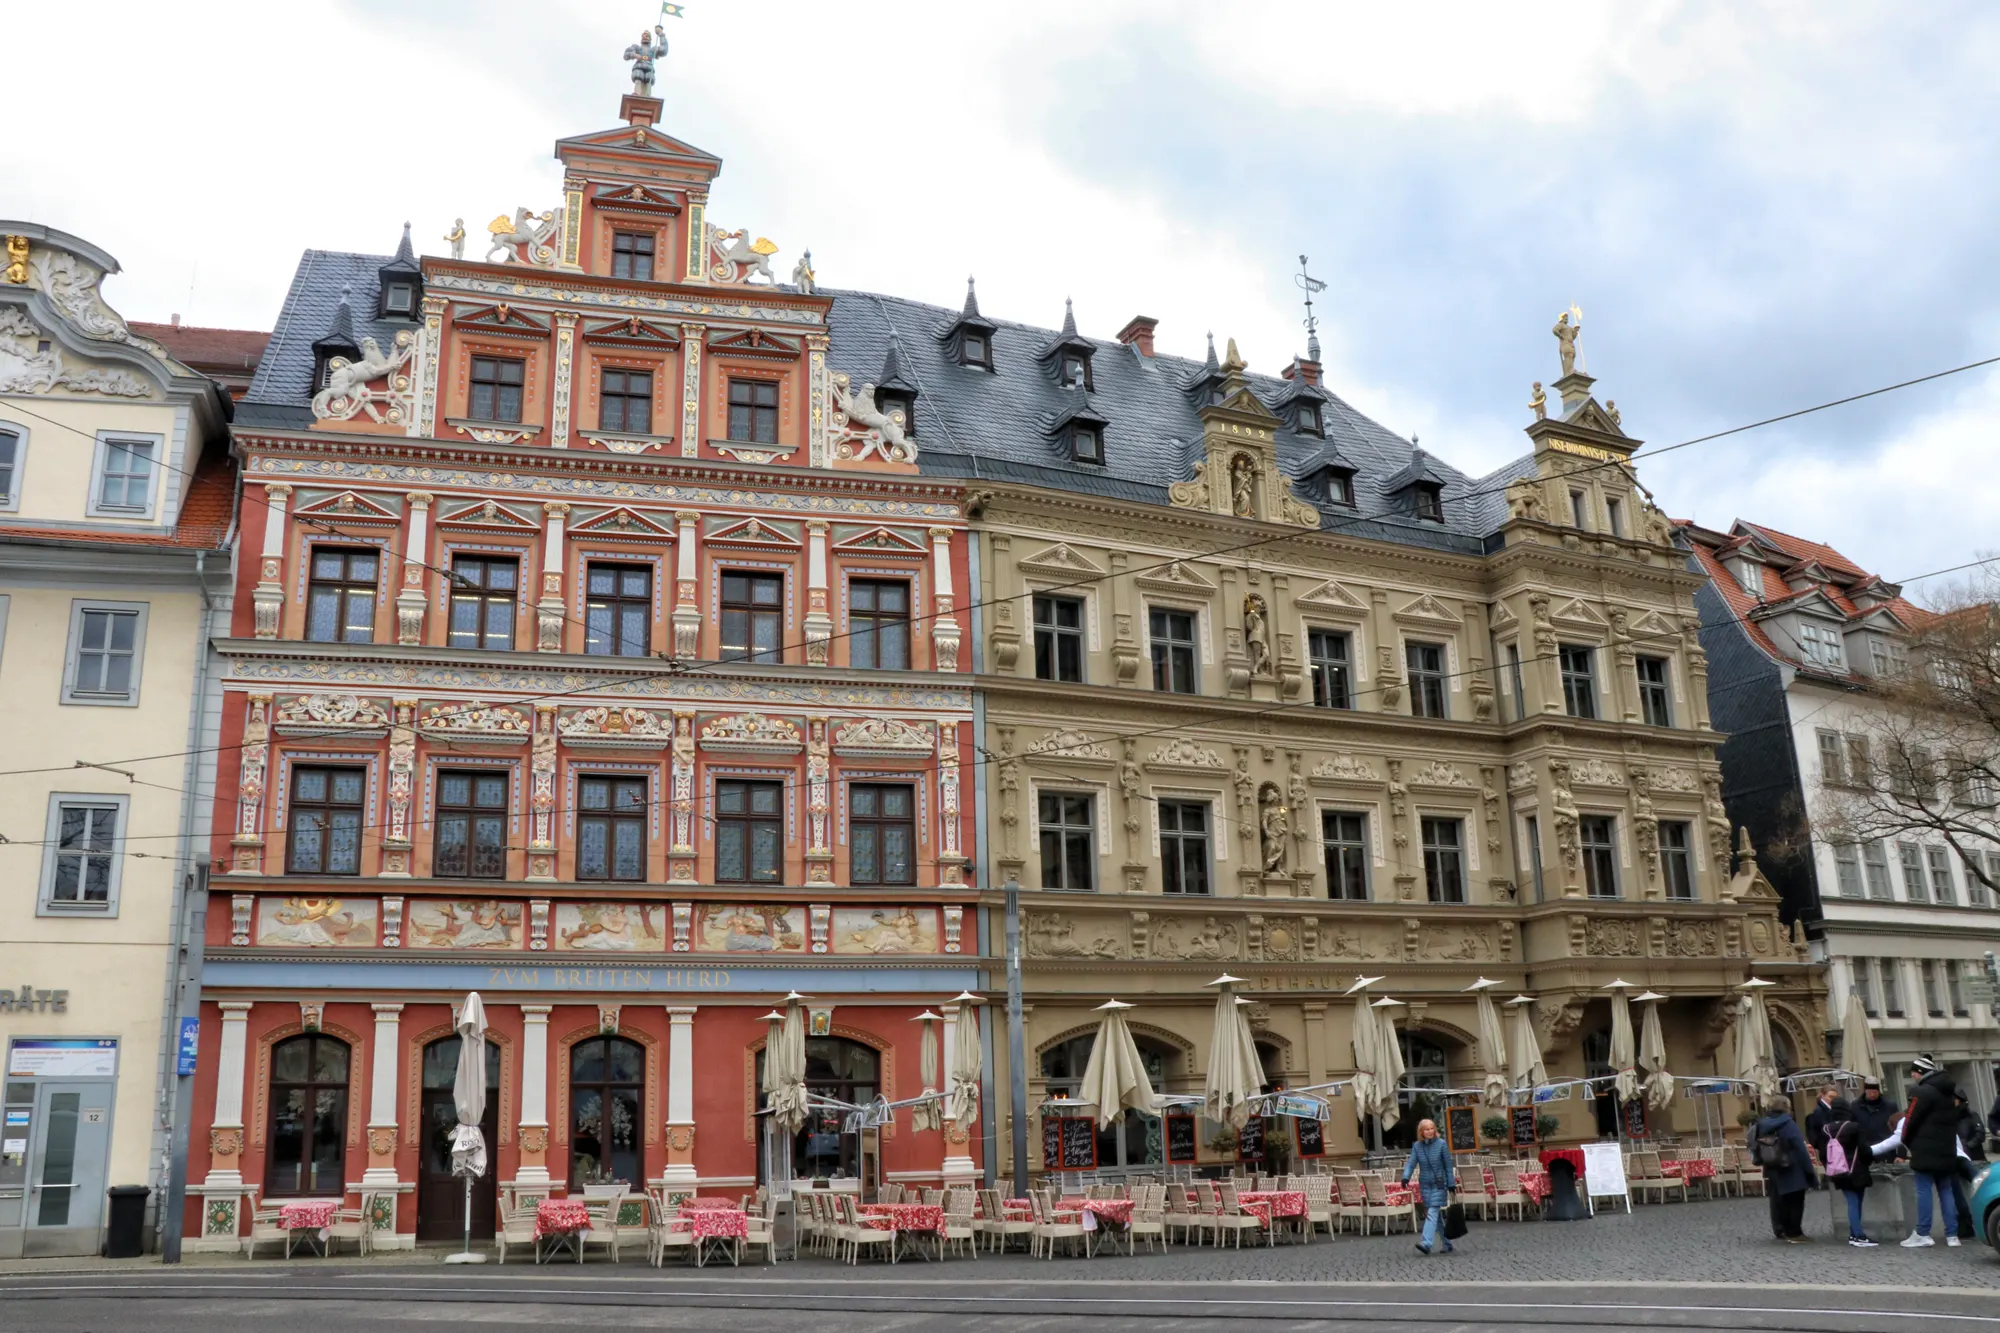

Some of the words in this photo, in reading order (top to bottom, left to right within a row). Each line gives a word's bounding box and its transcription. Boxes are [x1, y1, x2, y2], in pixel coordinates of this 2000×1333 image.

[1221, 423, 1265, 438] 1892
[555, 969, 650, 986] BREITEN
[666, 970, 731, 987] HERD
[89, 1114, 99, 1122] 12
